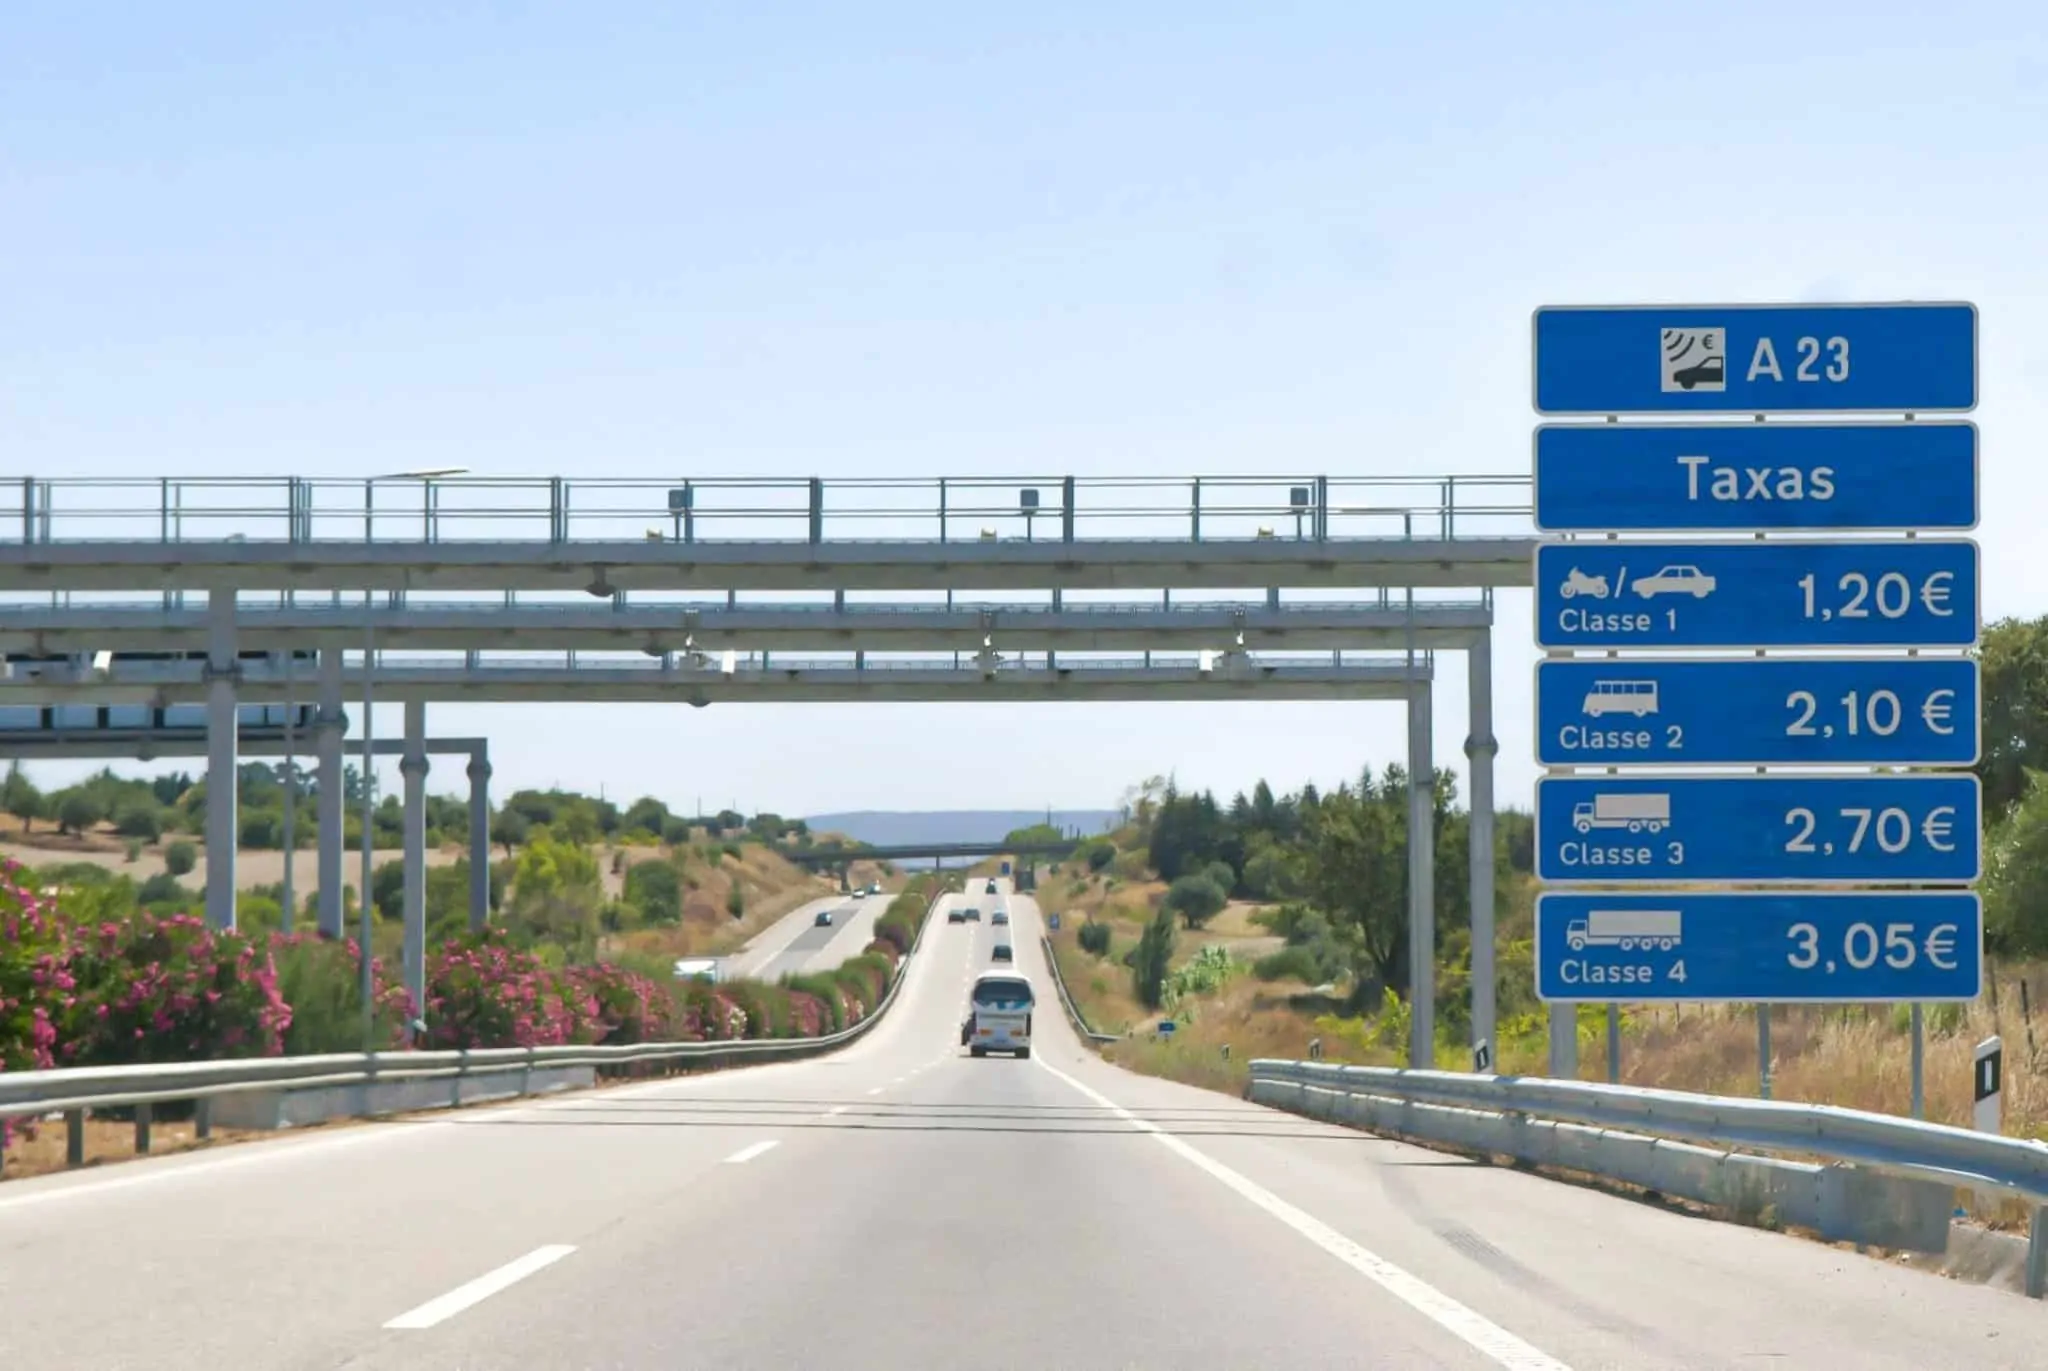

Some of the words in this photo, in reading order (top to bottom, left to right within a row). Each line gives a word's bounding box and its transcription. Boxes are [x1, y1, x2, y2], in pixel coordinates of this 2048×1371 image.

[1747, 337, 1783, 381] A
[1797, 336, 1849, 382] 23
[1677, 455, 1835, 500] Taxas
[1559, 608, 1651, 632] Classe
[1665, 608, 1678, 632] 1
[1786, 689, 1901, 738] 2,10
[1921, 689, 1955, 735] €
[1559, 725, 1651, 749] Classe
[1667, 725, 1682, 748] 2
[1560, 842, 1652, 865] Classe
[1668, 842, 1683, 865] 3
[1560, 959, 1652, 983] Classe
[1667, 959, 1688, 983] 4
